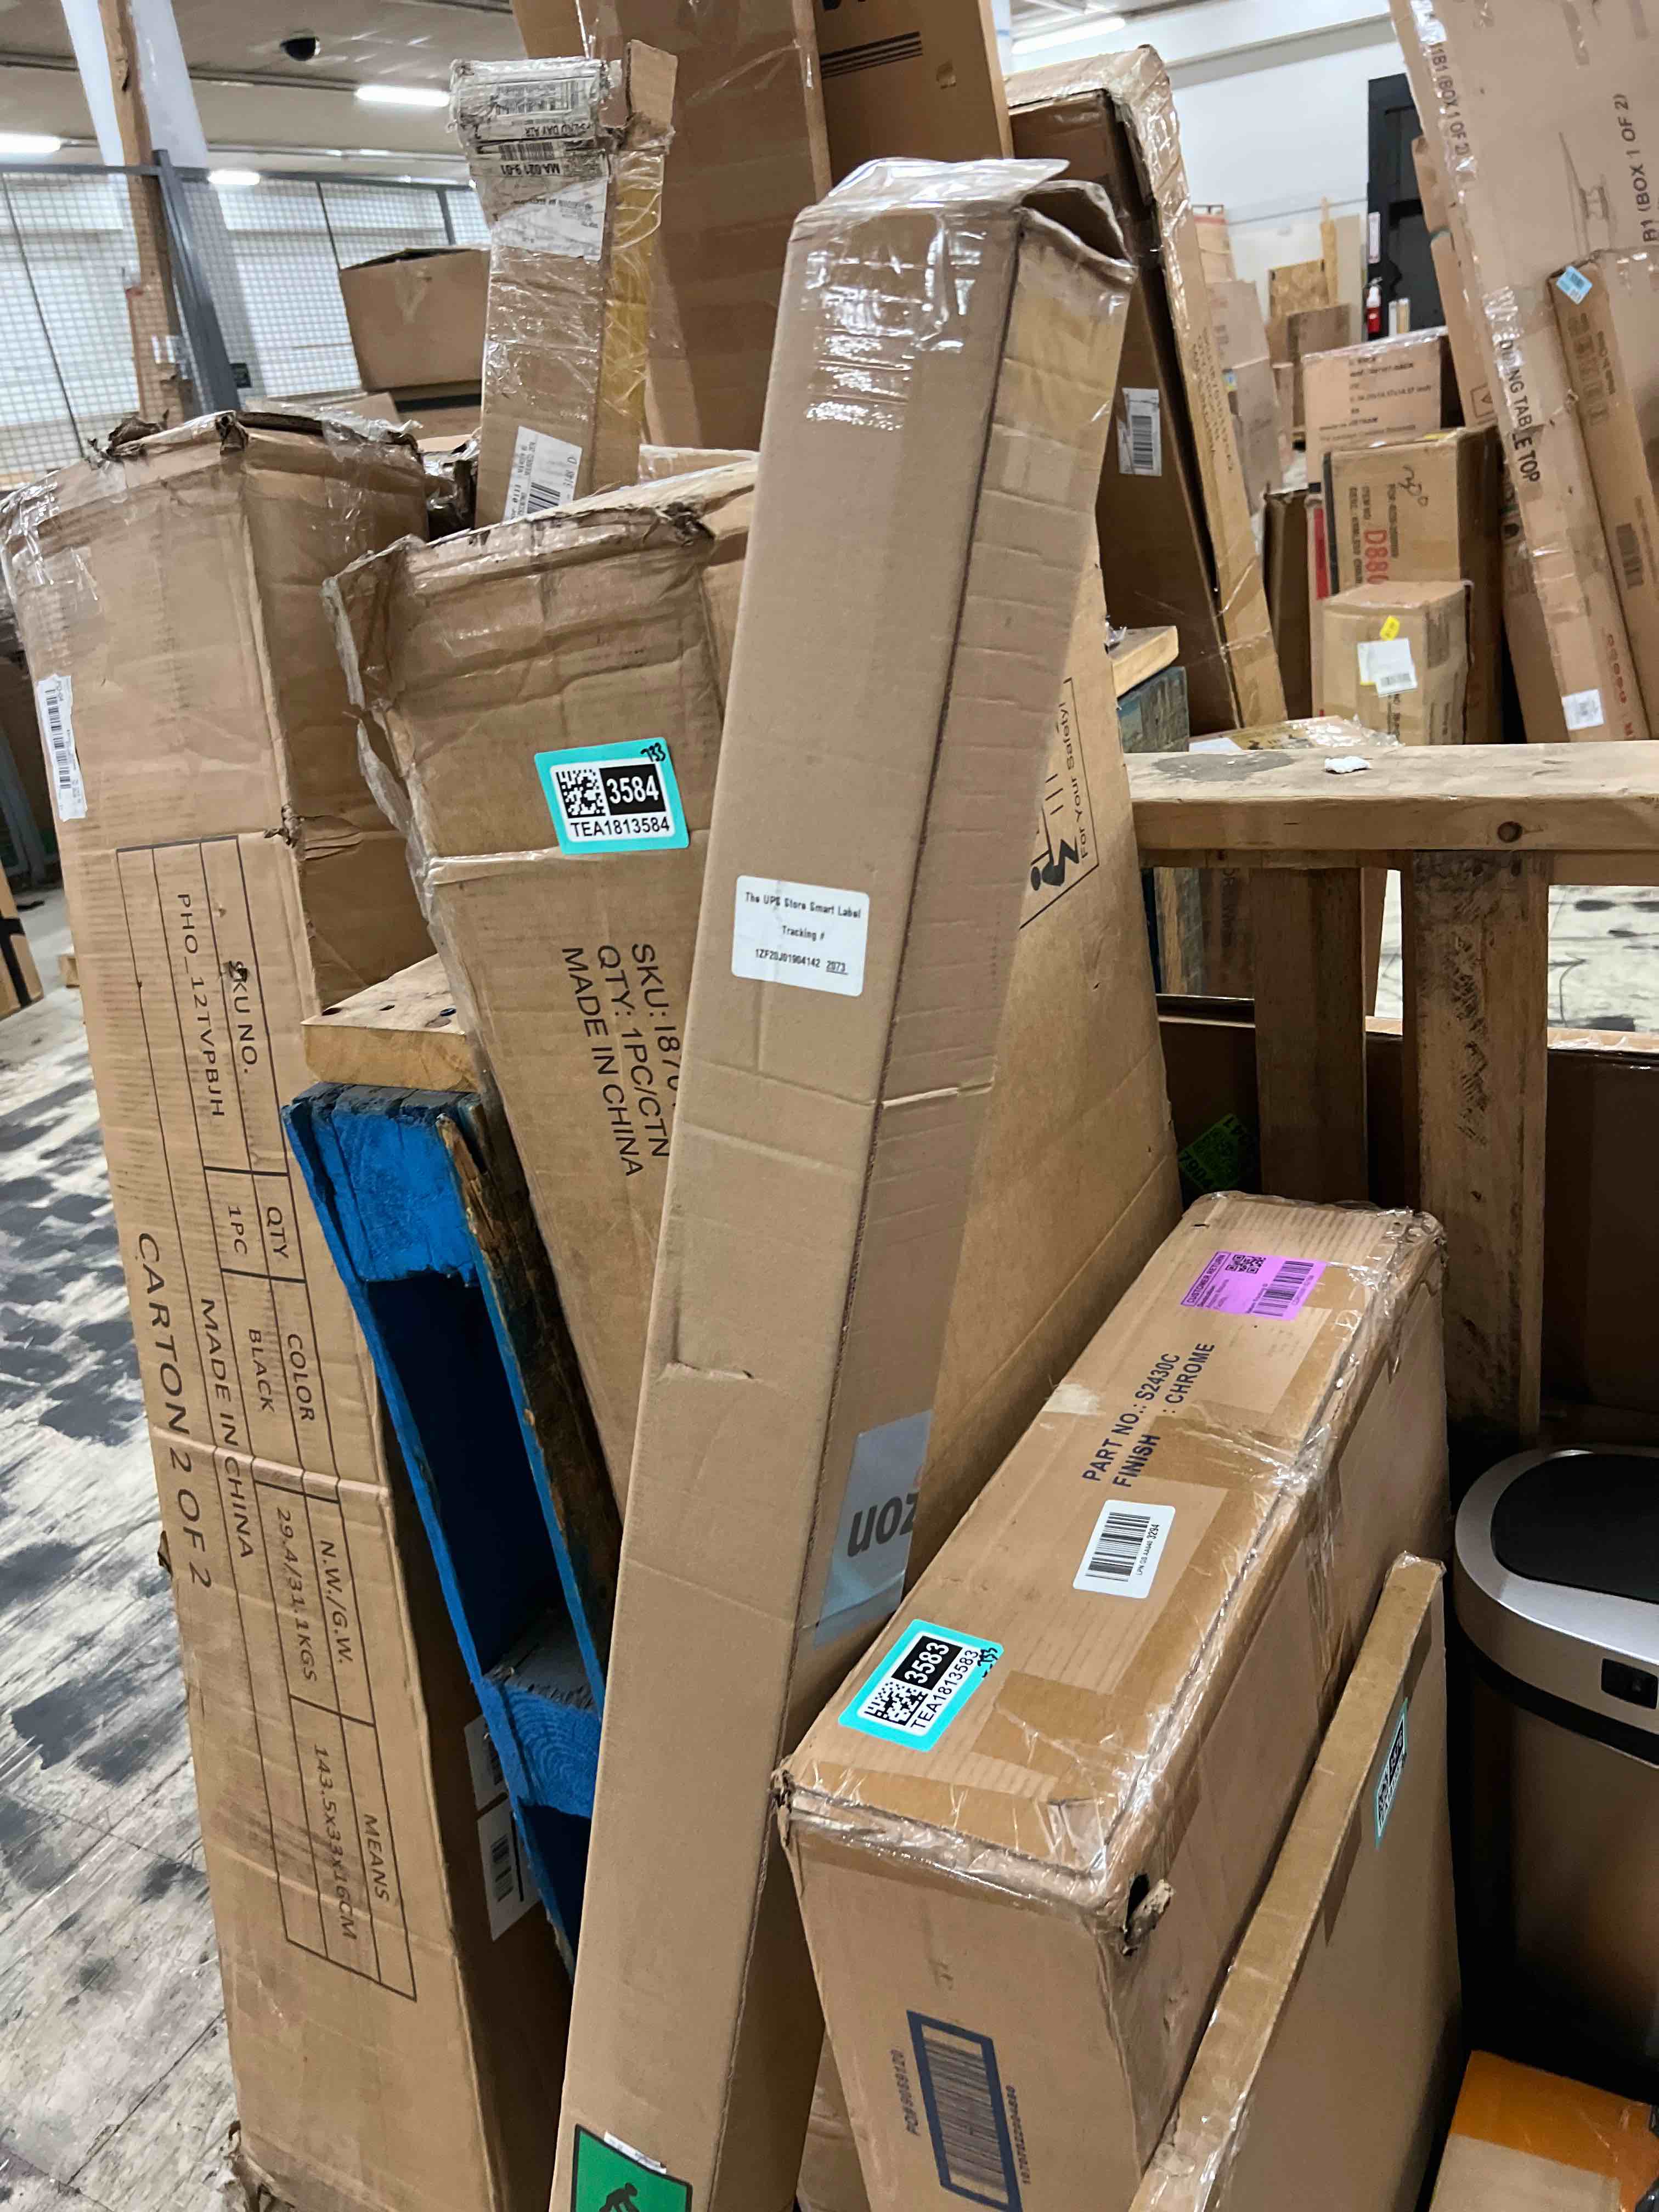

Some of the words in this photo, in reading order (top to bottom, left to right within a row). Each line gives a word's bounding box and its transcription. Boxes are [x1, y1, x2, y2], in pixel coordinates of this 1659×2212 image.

[1613, 93, 1629, 110] 2)
[1450, 122, 1466, 139] OF
[1618, 116, 1636, 142] OF
[1626, 149, 1640, 158] 1
[544, 164, 560, 174] MA
[1630, 163, 1651, 212] (BOX
[1512, 395, 1533, 450] TABLE
[1518, 450, 1541, 482] TOP
[1058, 702, 1075, 769] Safety!
[606, 775, 659, 804] 3584
[1071, 776, 1083, 823] Your
[571, 816, 669, 837] TEA1813584
[1079, 825, 1088, 859] For
[746, 891, 760, 904] The
[763, 895, 781, 906] UPS
[785, 898, 806, 910] Store
[810, 902, 834, 915] Smart
[838, 906, 861, 919] Label
[782, 925, 816, 942] Tracking
[177, 893, 225, 1117] PHO_12TVPBJH
[562, 947, 609, 1037] MADE
[238, 1024, 257, 1074] NO.
[591, 1046, 619, 1074] IN
[598, 945, 635, 1016] QTY:
[621, 1028, 669, 1156] 1PC/CTN
[603, 1084, 644, 1176] CHINA
[228, 1205, 249, 1255] 1PC
[267, 1206, 290, 1259] QTY
[1187, 1275, 1212, 1303] CUSTOMER
[1207, 1255, 1226, 1274] RETURN
[138, 1232, 190, 1435] CARTON
[200, 1298, 232, 1401] MADE
[248, 1328, 275, 1412] BLACK
[287, 1334, 315, 1422] COLOR
[219, 1413, 239, 1446] IN
[1082, 1438, 1123, 1481] PART
[1135, 1353, 1181, 1401] S2430C
[1112, 1434, 1161, 1487] FINISH
[1165, 1343, 1215, 1404] CHROME
[170, 1447, 192, 1471] 2
[178, 1488, 205, 1553] OF
[223, 1456, 254, 1559] CHINA
[1147, 1524, 1159, 1539] 3294
[190, 1562, 212, 1588] 2
[276, 1508, 317, 1682] 29.4/31.1KGS
[320, 1541, 353, 1664] N.W./G.W.
[904, 1642, 950, 1684] 3583
[910, 1650, 979, 1728] TEA1813583
[364, 1814, 390, 1902] MEANS
